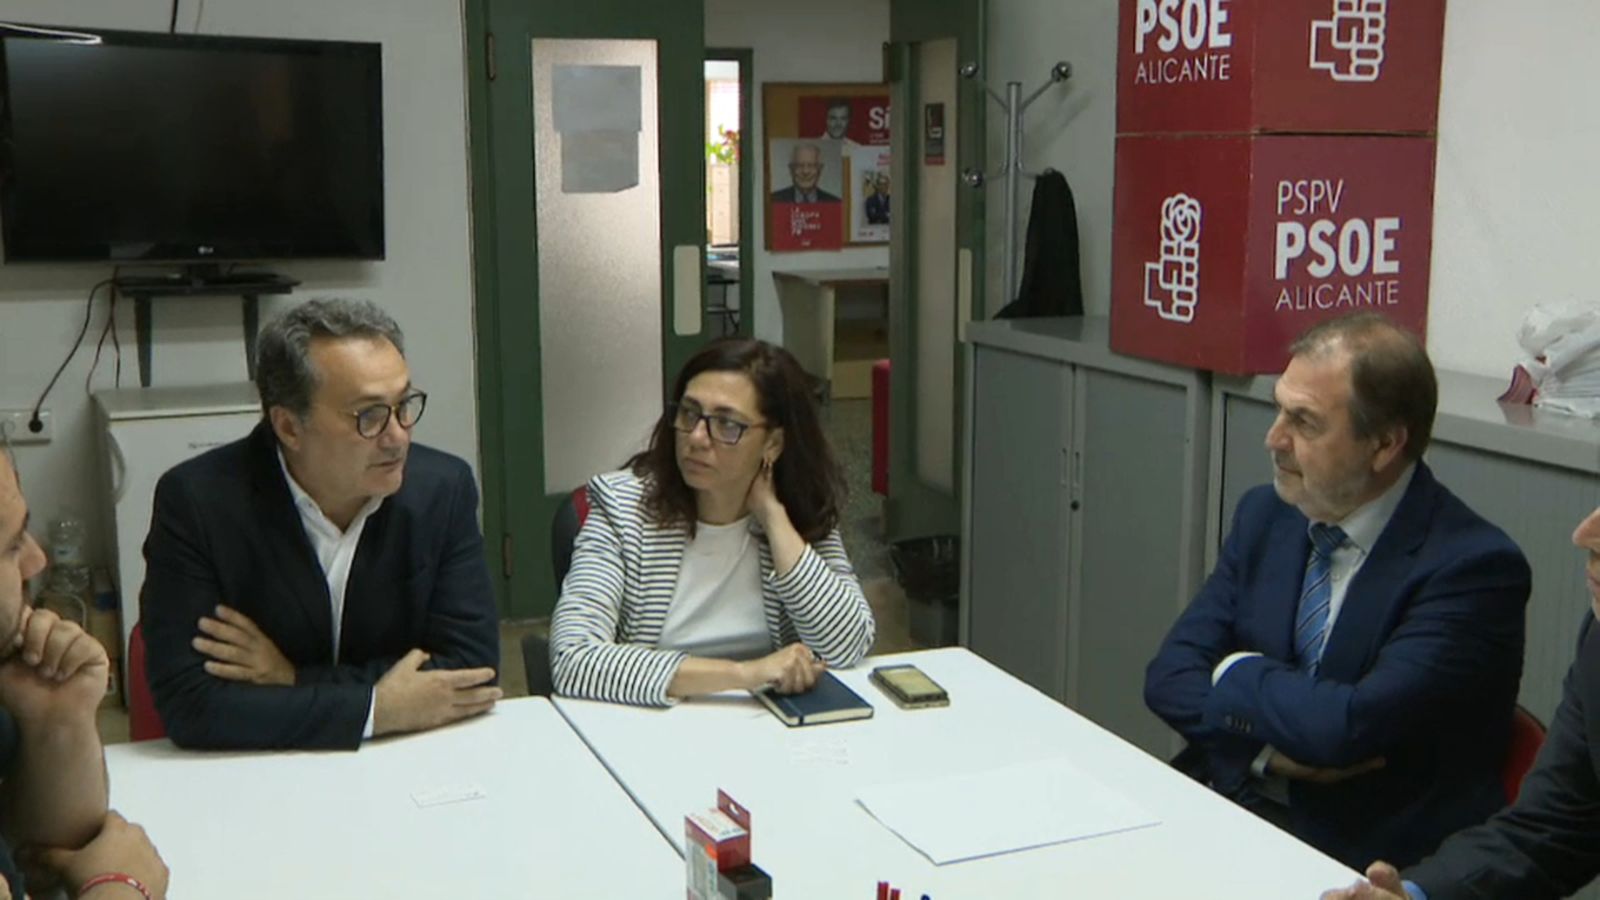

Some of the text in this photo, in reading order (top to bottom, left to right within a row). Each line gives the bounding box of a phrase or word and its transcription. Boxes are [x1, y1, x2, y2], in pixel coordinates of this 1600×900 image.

[1134, 0, 1232, 55] PSOE
[1134, 53, 1231, 85] ALICANTE
[1277, 179, 1344, 215] PSPV
[1275, 217, 1400, 280] PSOE
[1275, 280, 1400, 311] ALICANTE
